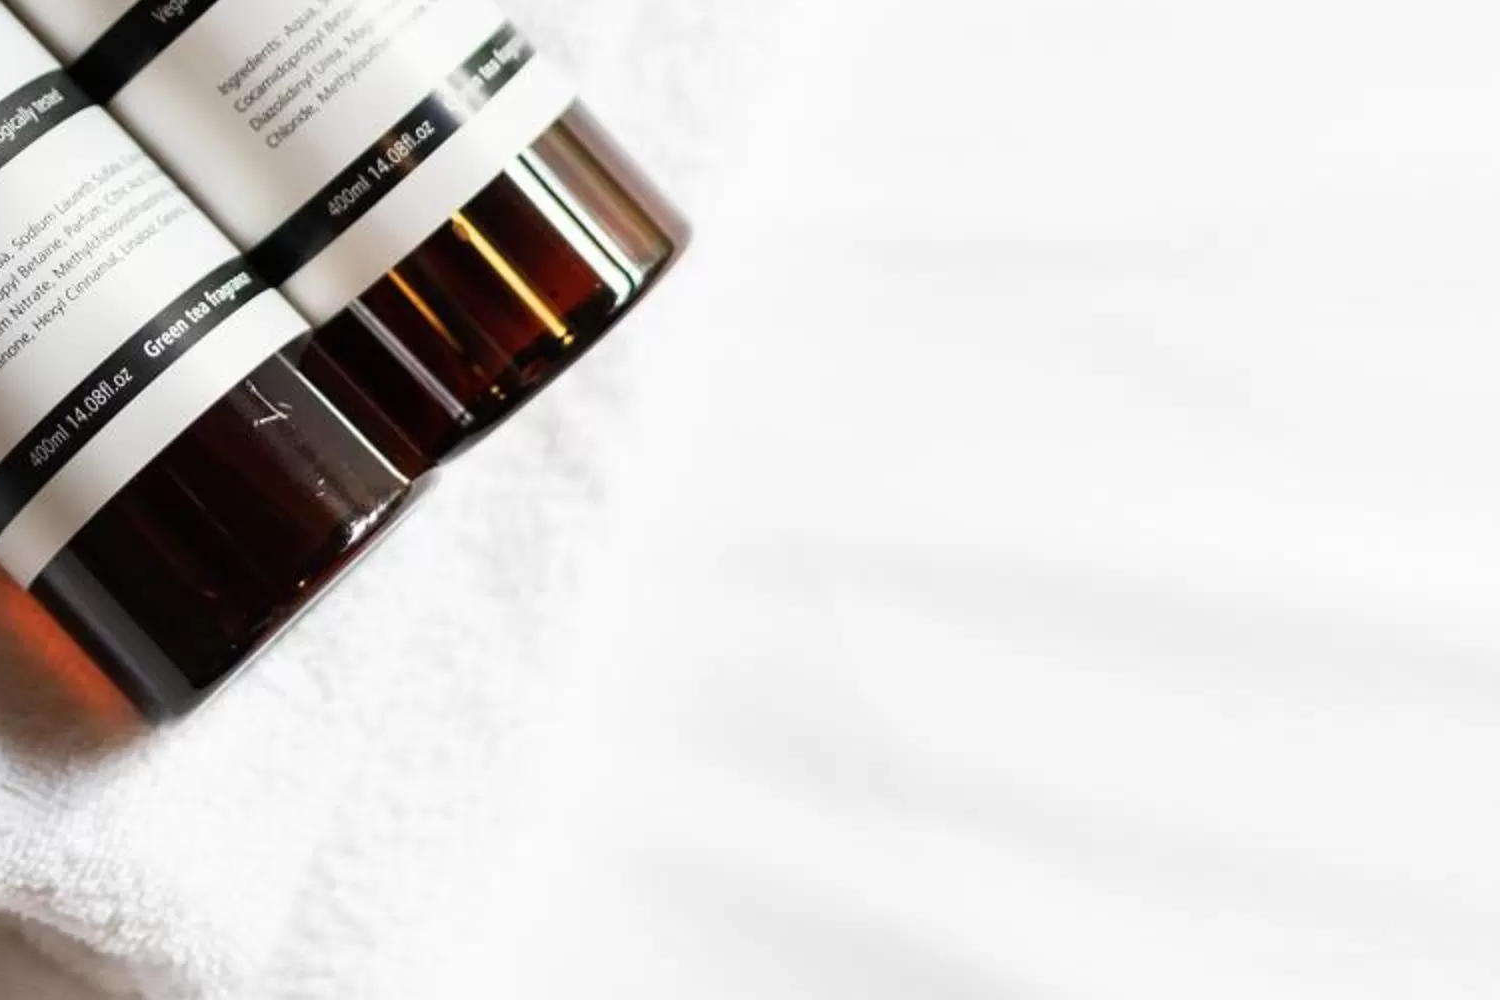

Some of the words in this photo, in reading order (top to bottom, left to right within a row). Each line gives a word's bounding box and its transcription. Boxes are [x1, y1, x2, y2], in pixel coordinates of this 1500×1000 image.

[328, 173, 372, 215] 400ml
[367, 118, 436, 180] 14.08fl.oz
[11, 210, 57, 252] Sodium
[16, 236, 66, 279] Betaine,
[8, 279, 56, 320] Nitrate,
[31, 296, 66, 331] Hexyl
[29, 423, 70, 466] 400ml
[65, 367, 134, 430] 14.08fl.oz
[143, 318, 189, 358] Green
[183, 298, 212, 323] tea
